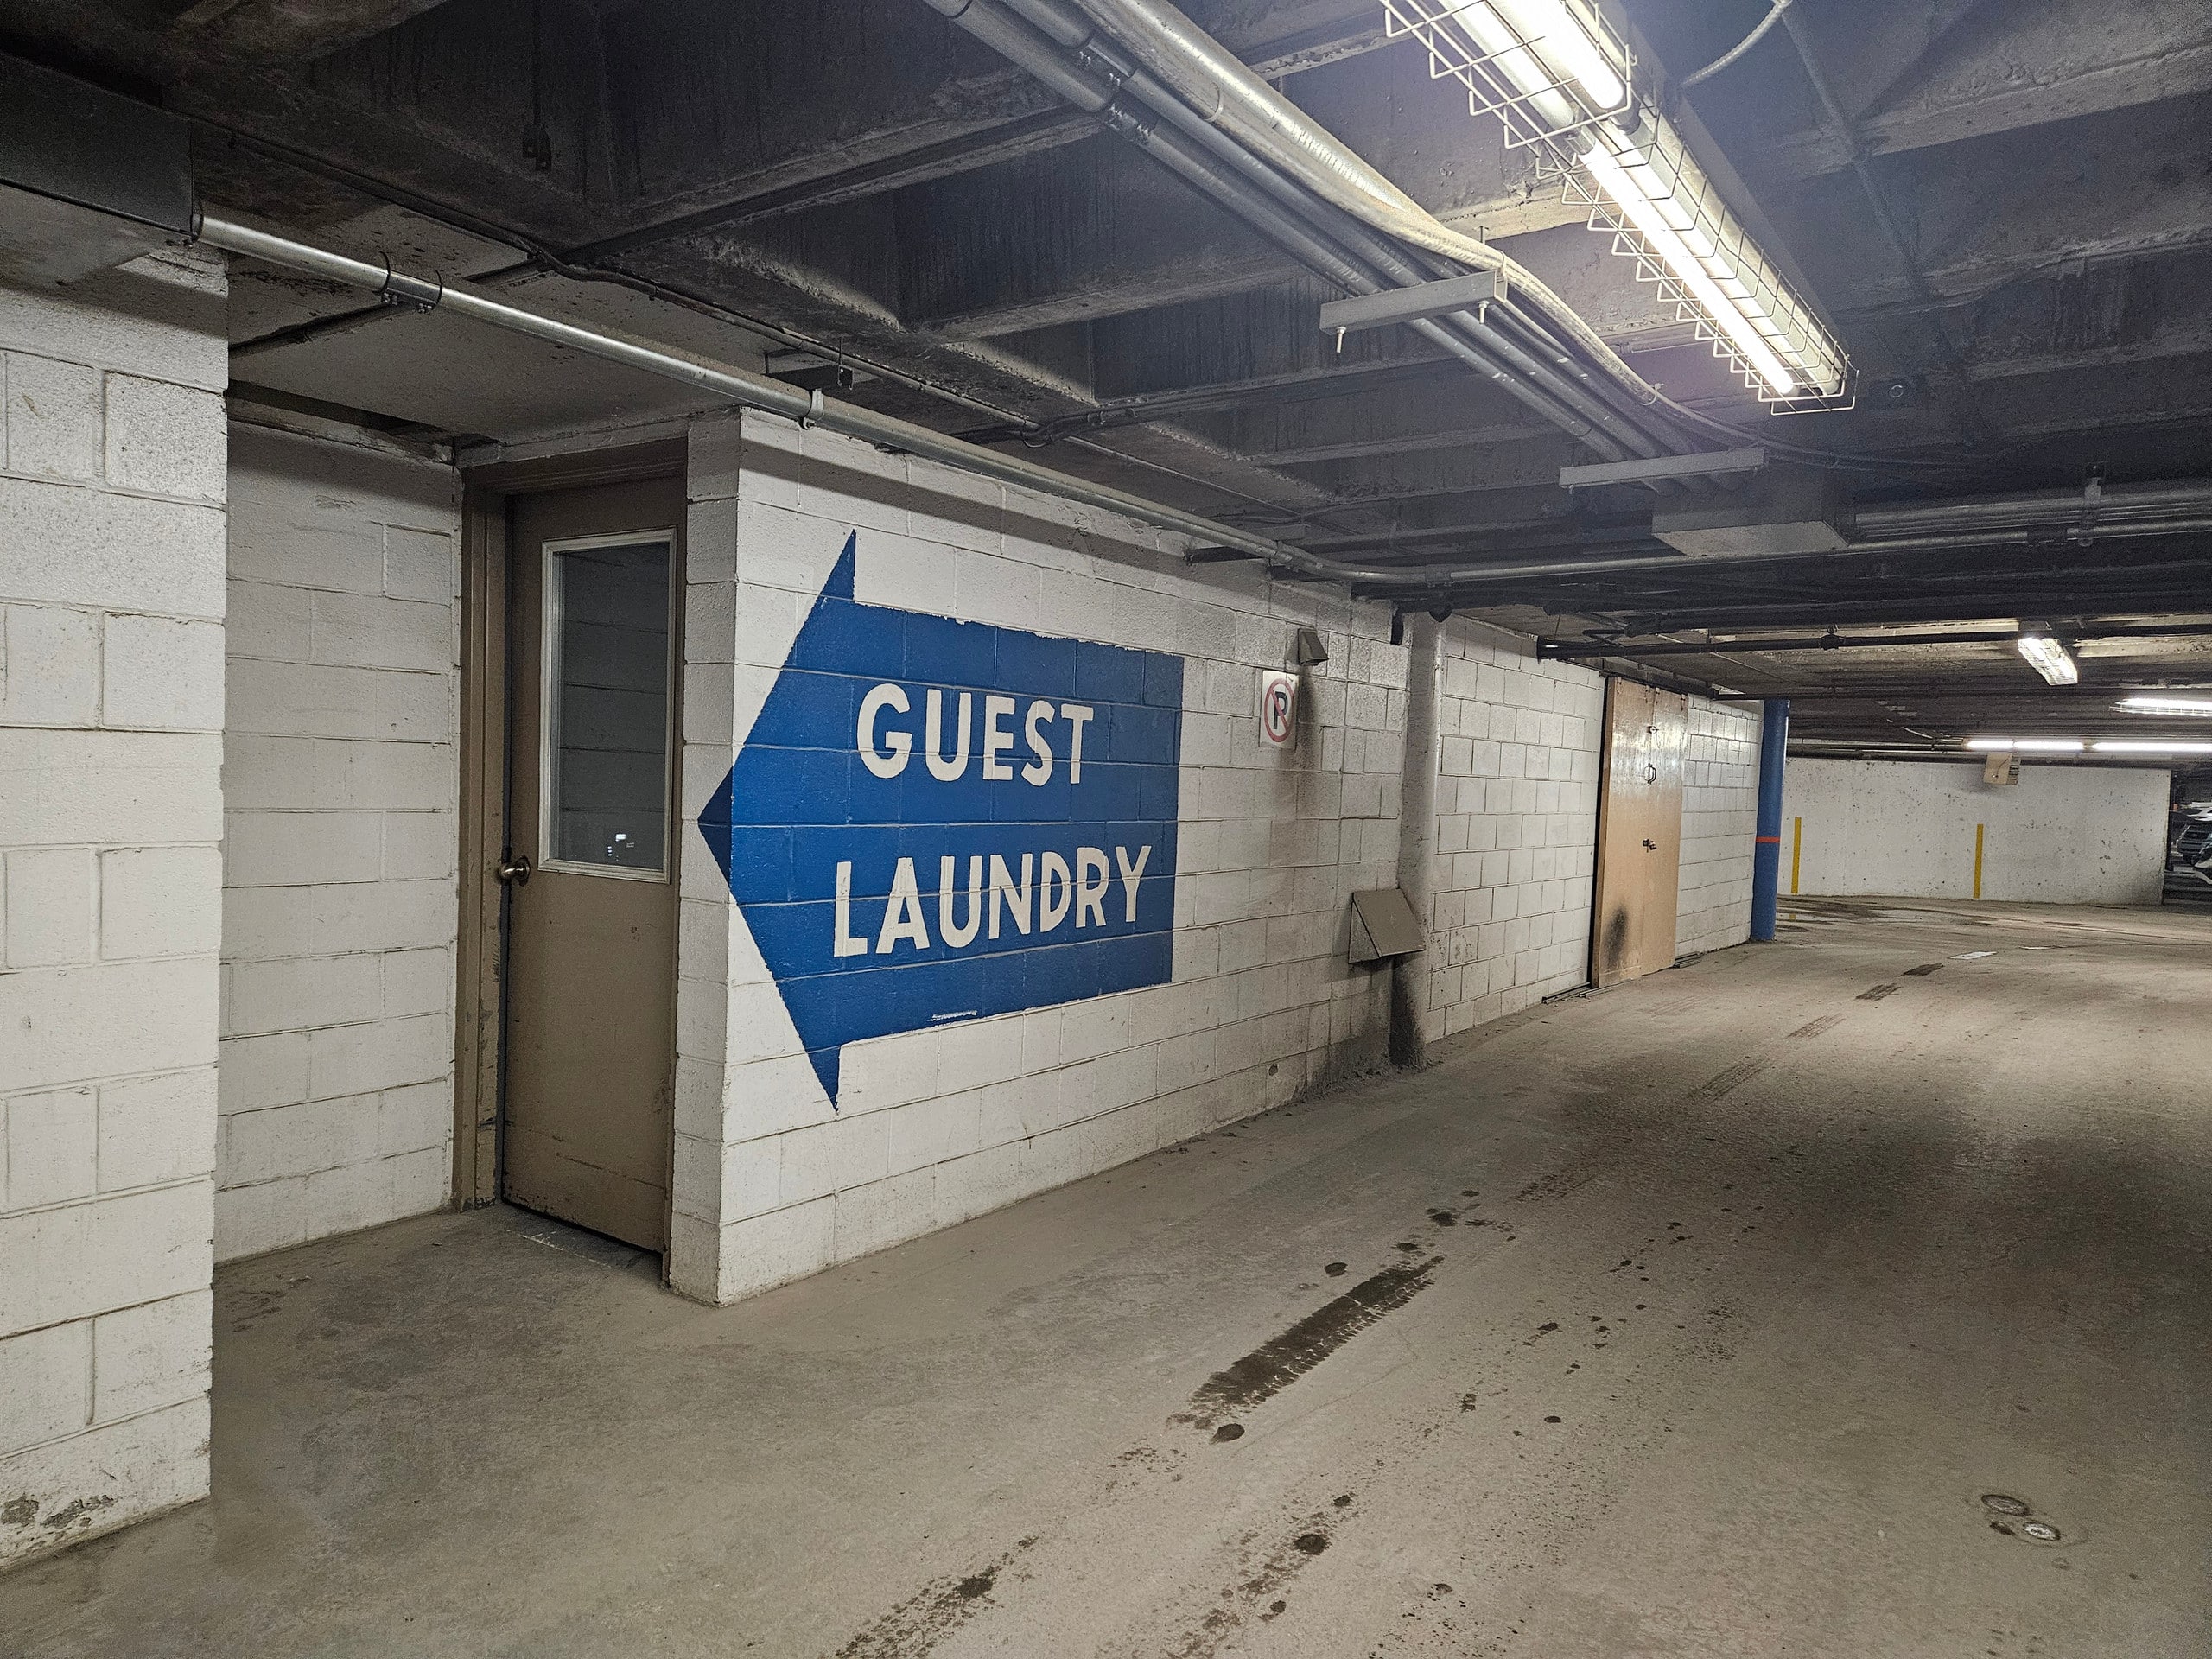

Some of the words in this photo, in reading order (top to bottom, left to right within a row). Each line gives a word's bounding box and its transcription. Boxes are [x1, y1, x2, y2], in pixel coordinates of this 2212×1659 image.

[856, 683, 1095, 786] GUEST
[1273, 690, 1288, 730] P
[833, 845, 1152, 958] LAUNDRY
